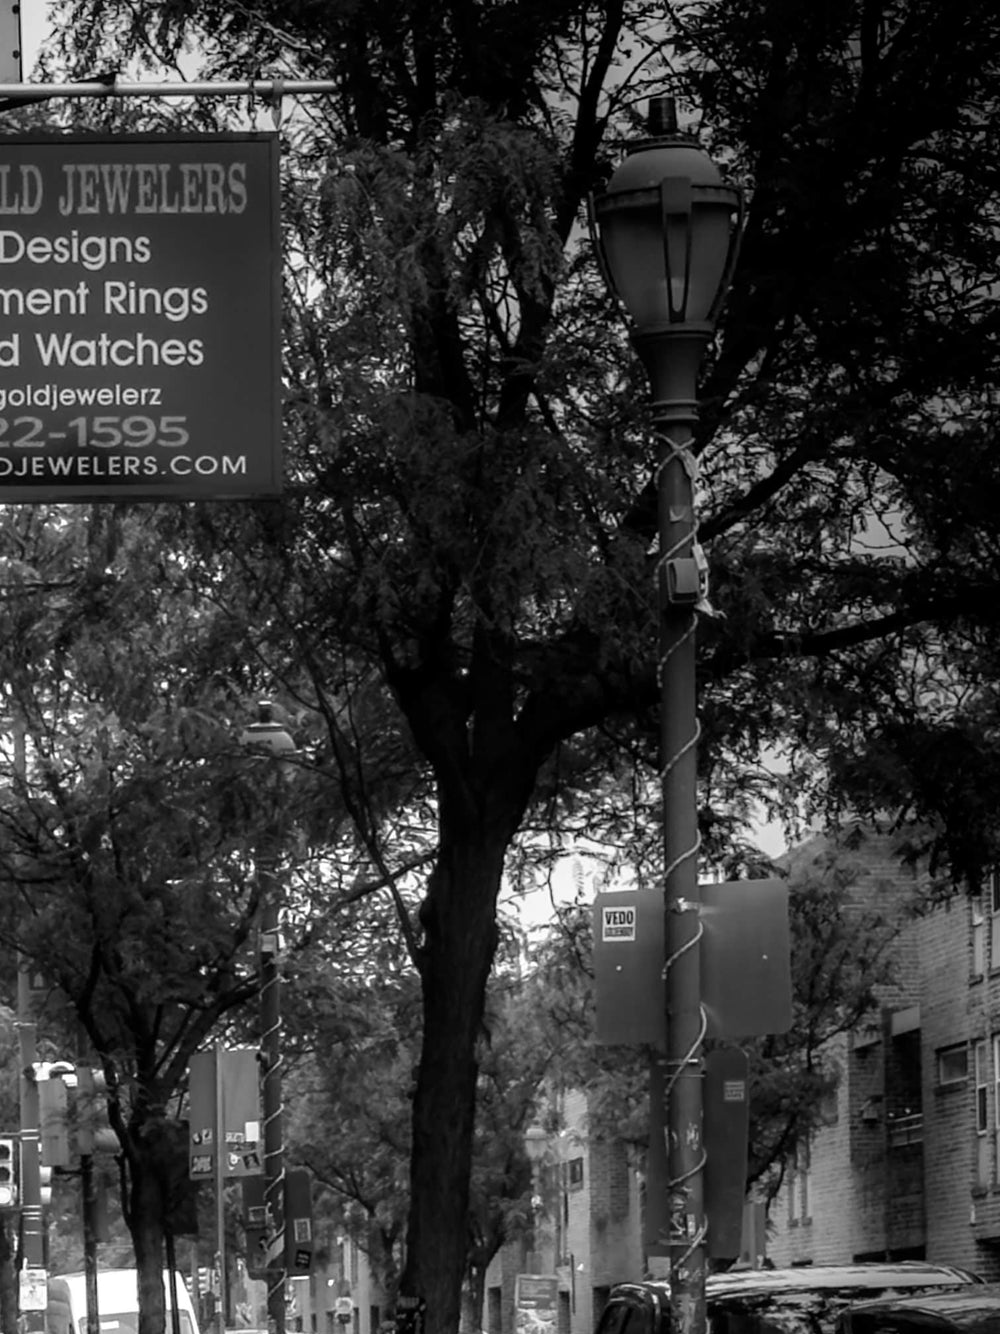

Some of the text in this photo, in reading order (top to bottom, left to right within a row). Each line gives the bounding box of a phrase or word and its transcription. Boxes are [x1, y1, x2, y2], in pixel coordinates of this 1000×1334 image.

[59, 162, 247, 216] JEWELERS
[104, 281, 208, 321] Rings
[35, 333, 204, 367] Watches
[605, 911, 634, 925] VEDO
